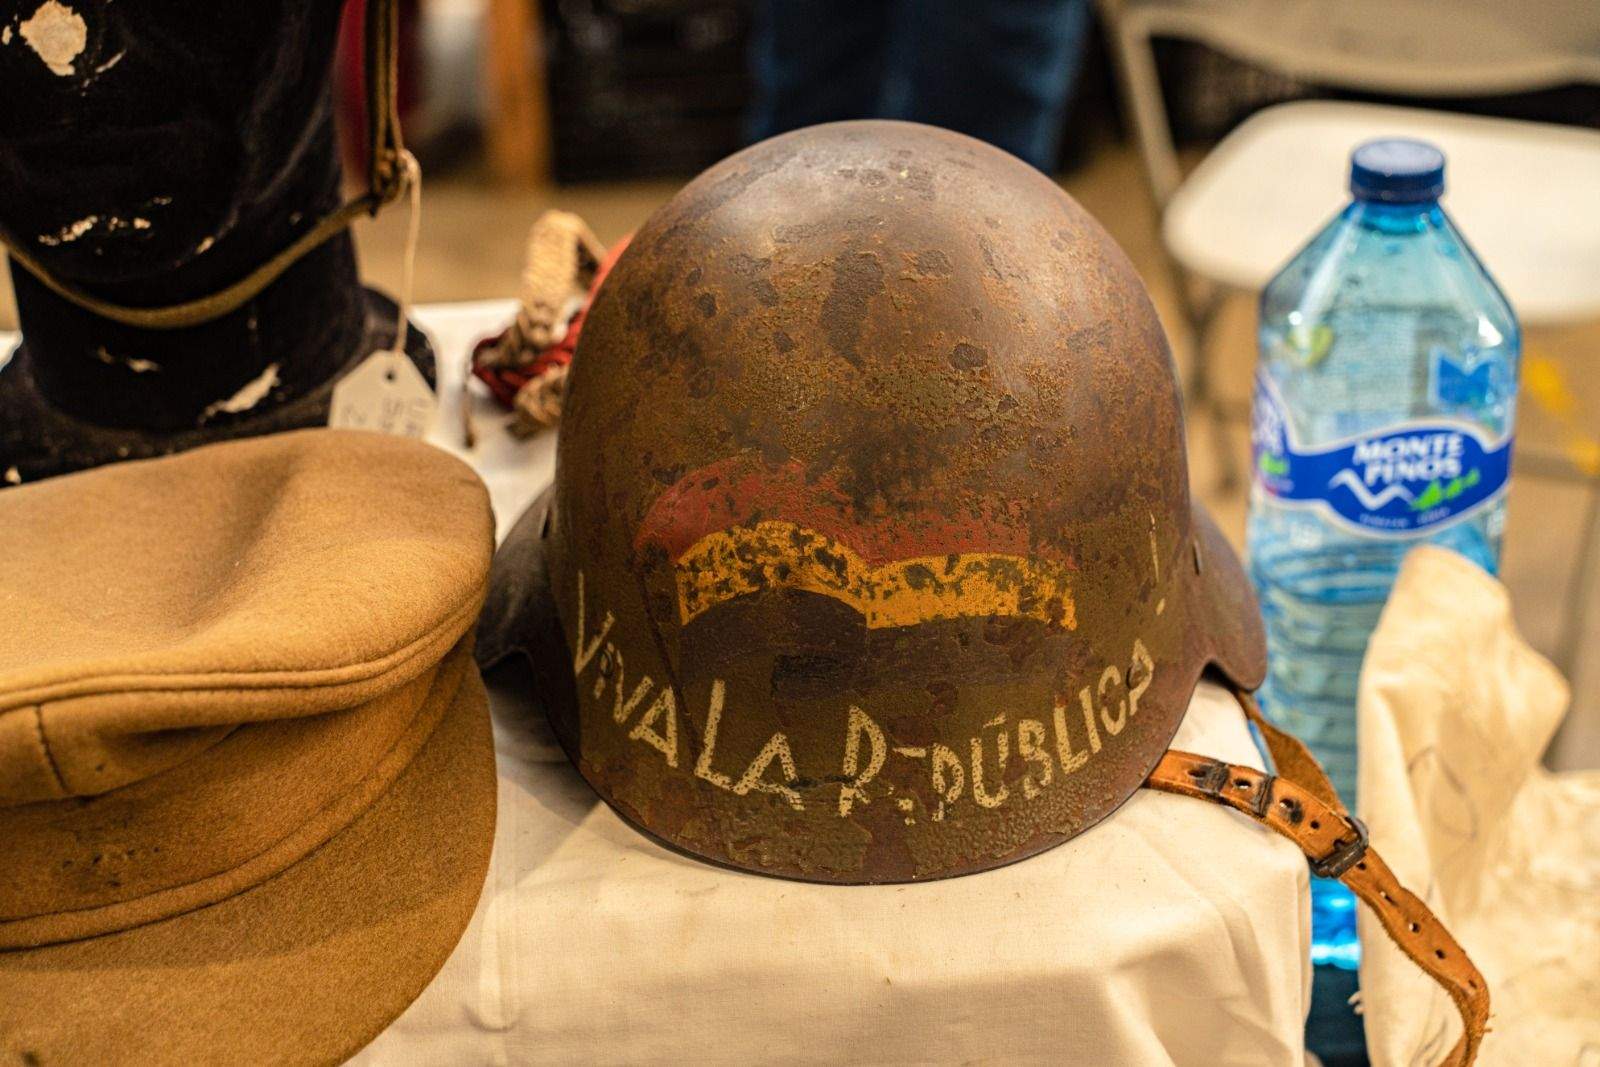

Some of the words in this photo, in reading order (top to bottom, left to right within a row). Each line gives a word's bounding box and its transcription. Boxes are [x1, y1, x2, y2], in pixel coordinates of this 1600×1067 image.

[1353, 433, 1462, 464] MONTE
[574, 570, 678, 768] VIVA
[694, 679, 805, 811] LA
